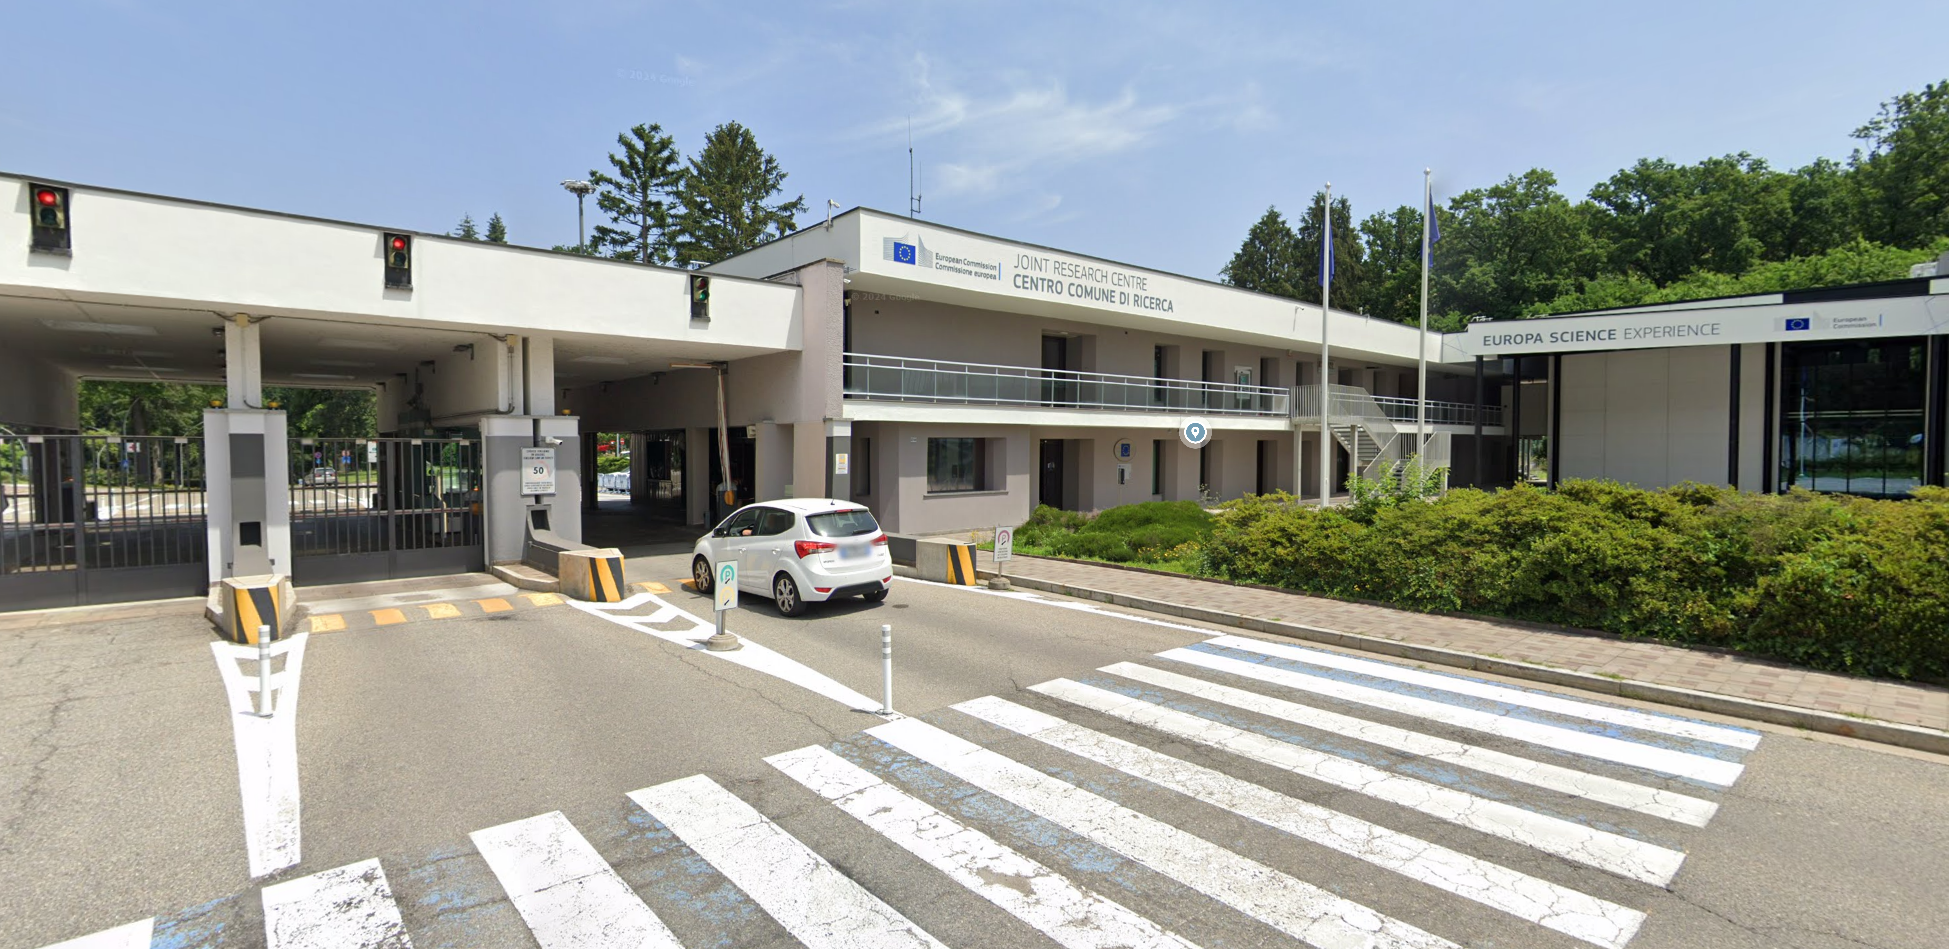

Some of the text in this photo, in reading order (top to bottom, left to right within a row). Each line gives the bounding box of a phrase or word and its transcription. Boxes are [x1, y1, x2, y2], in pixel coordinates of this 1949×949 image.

[935, 253, 997, 271] European Commission
[935, 262, 997, 280] Commissione europea
[1013, 254, 1148, 291] JOINT RESEARCH CENTRE
[1013, 273, 1174, 313] CENTRO COMUNE DI RICERCA
[1483, 322, 1721, 347] EUROPA SCIENCE EXPERIENCE
[1832, 322, 1877, 330] Commission
[533, 466, 544, 475] 50
[725, 570, 731, 579] P
